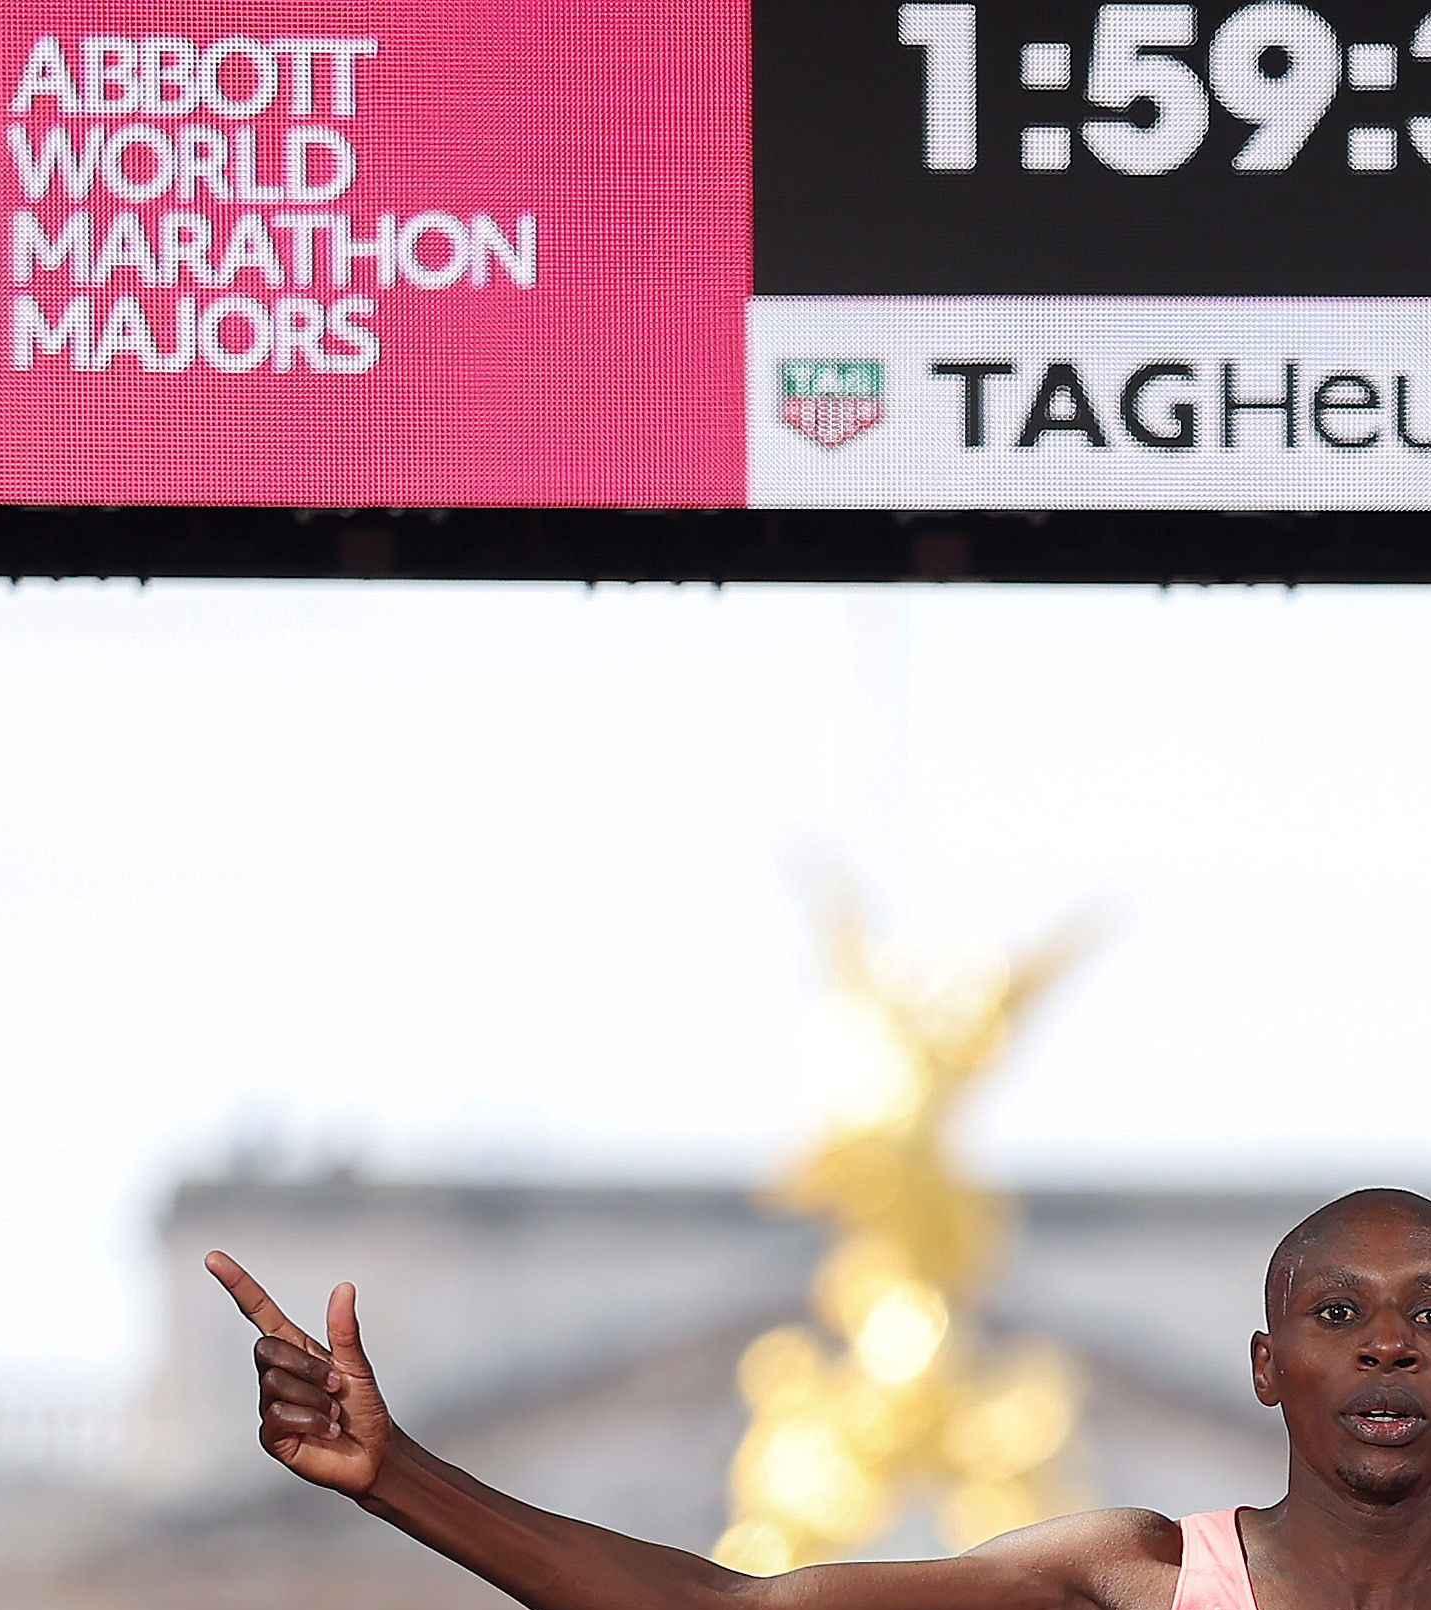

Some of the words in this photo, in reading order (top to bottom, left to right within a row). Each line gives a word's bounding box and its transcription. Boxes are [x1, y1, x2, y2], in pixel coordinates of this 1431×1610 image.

[10, 34, 379, 118] ABBOTT
[6, 124, 357, 206] WORLD
[10, 210, 539, 290] MARATHON
[10, 295, 381, 373] MAJORS
